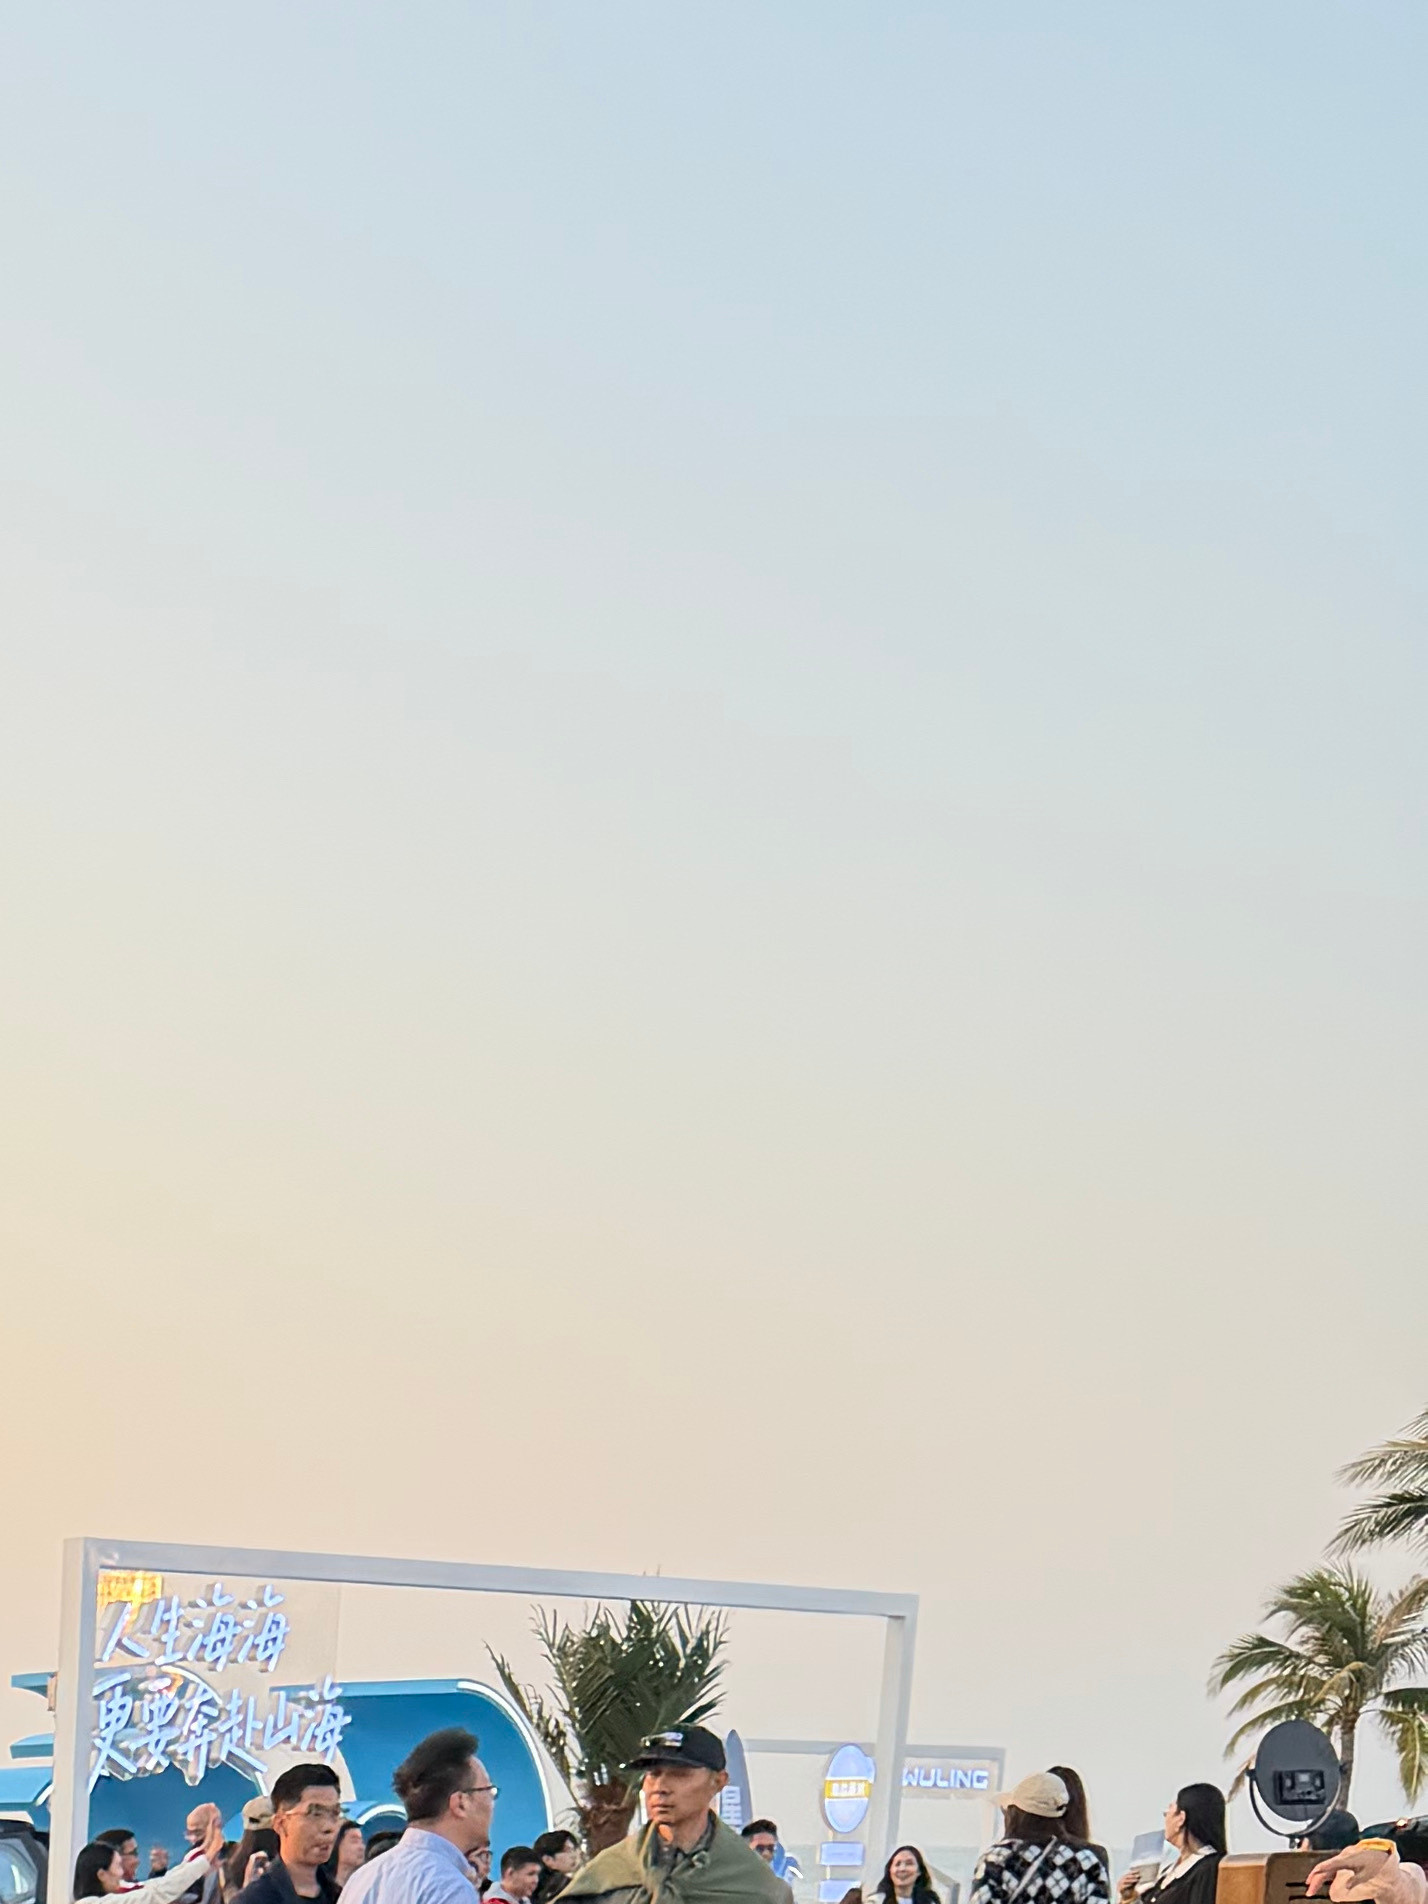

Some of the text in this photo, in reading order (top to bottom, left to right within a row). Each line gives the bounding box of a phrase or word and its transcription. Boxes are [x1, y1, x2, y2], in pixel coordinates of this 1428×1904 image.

[101, 1582, 290, 1672] 人生海海
[89, 1672, 352, 1795] 更要奔赴山海
[902, 1767, 989, 1790] WULING
